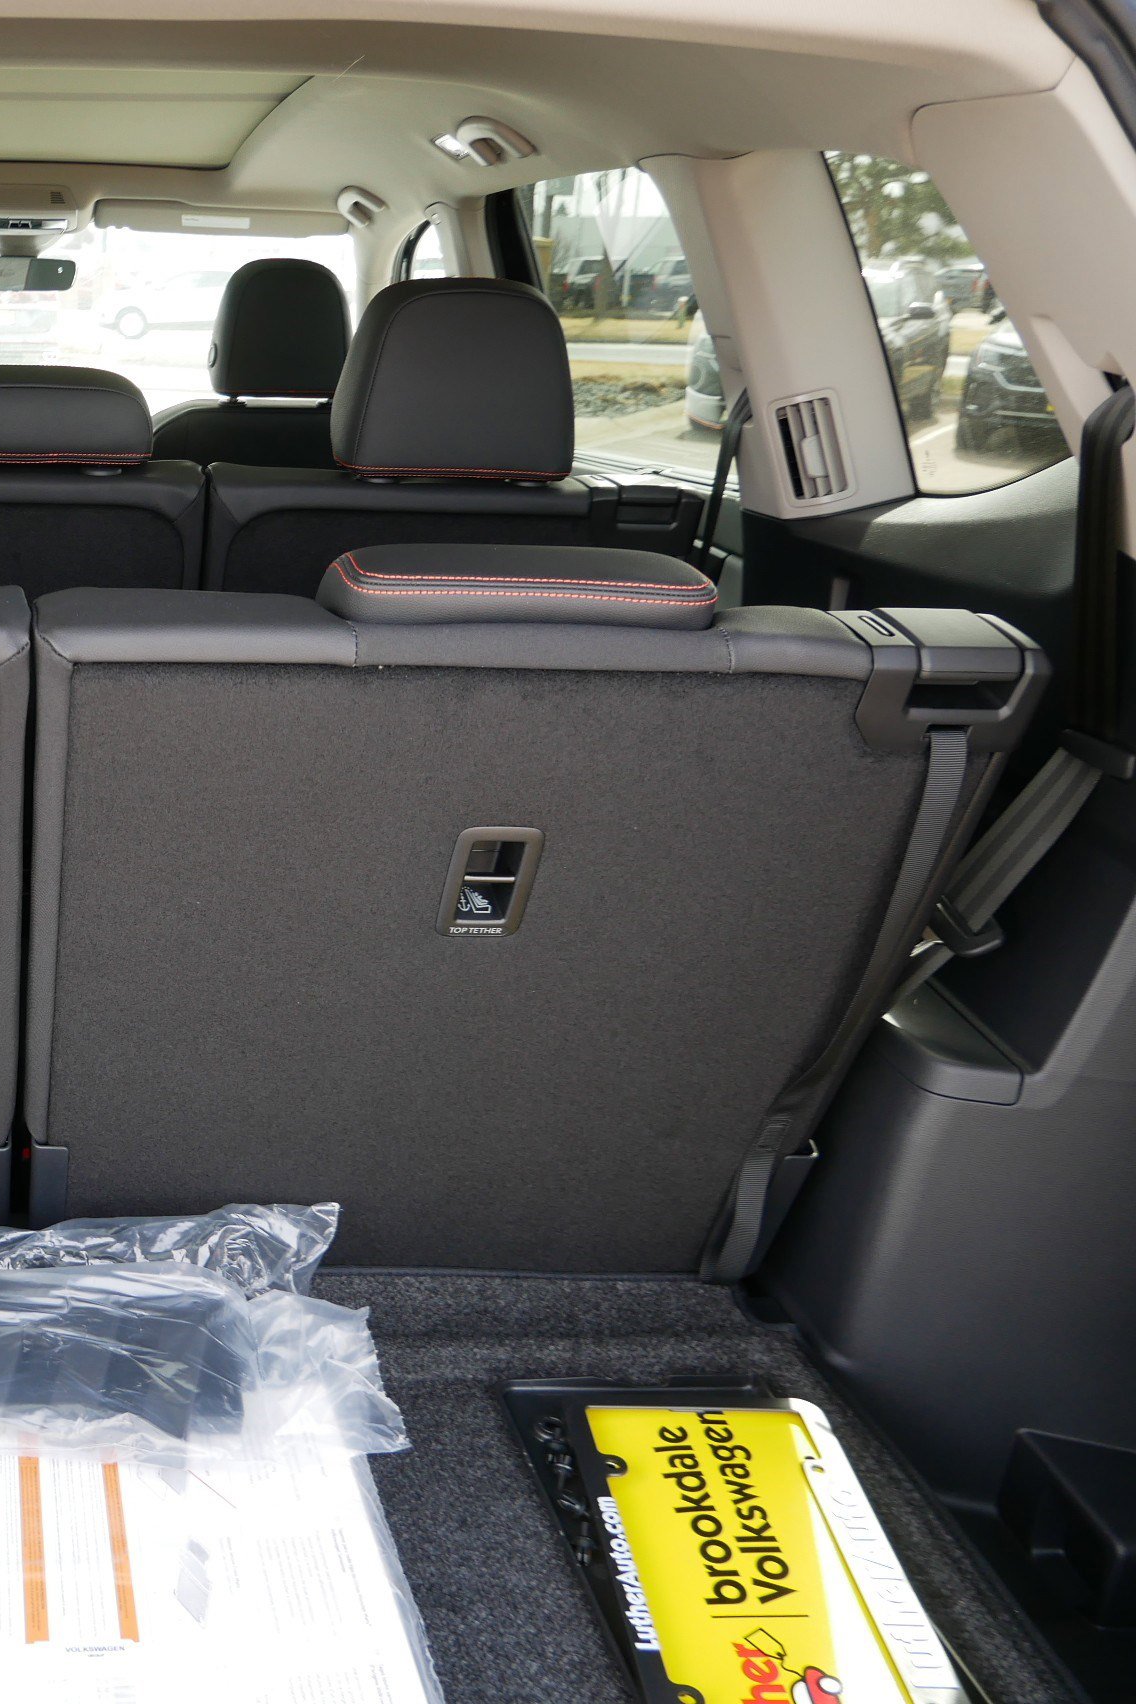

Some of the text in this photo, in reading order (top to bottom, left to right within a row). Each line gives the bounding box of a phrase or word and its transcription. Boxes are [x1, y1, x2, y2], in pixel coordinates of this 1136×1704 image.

[449, 926, 468, 934] TOP
[597, 1496, 661, 1651] LutherAuto.com
[653, 1424, 748, 1605] brookdale
[695, 1410, 797, 1605] Volkswagen
